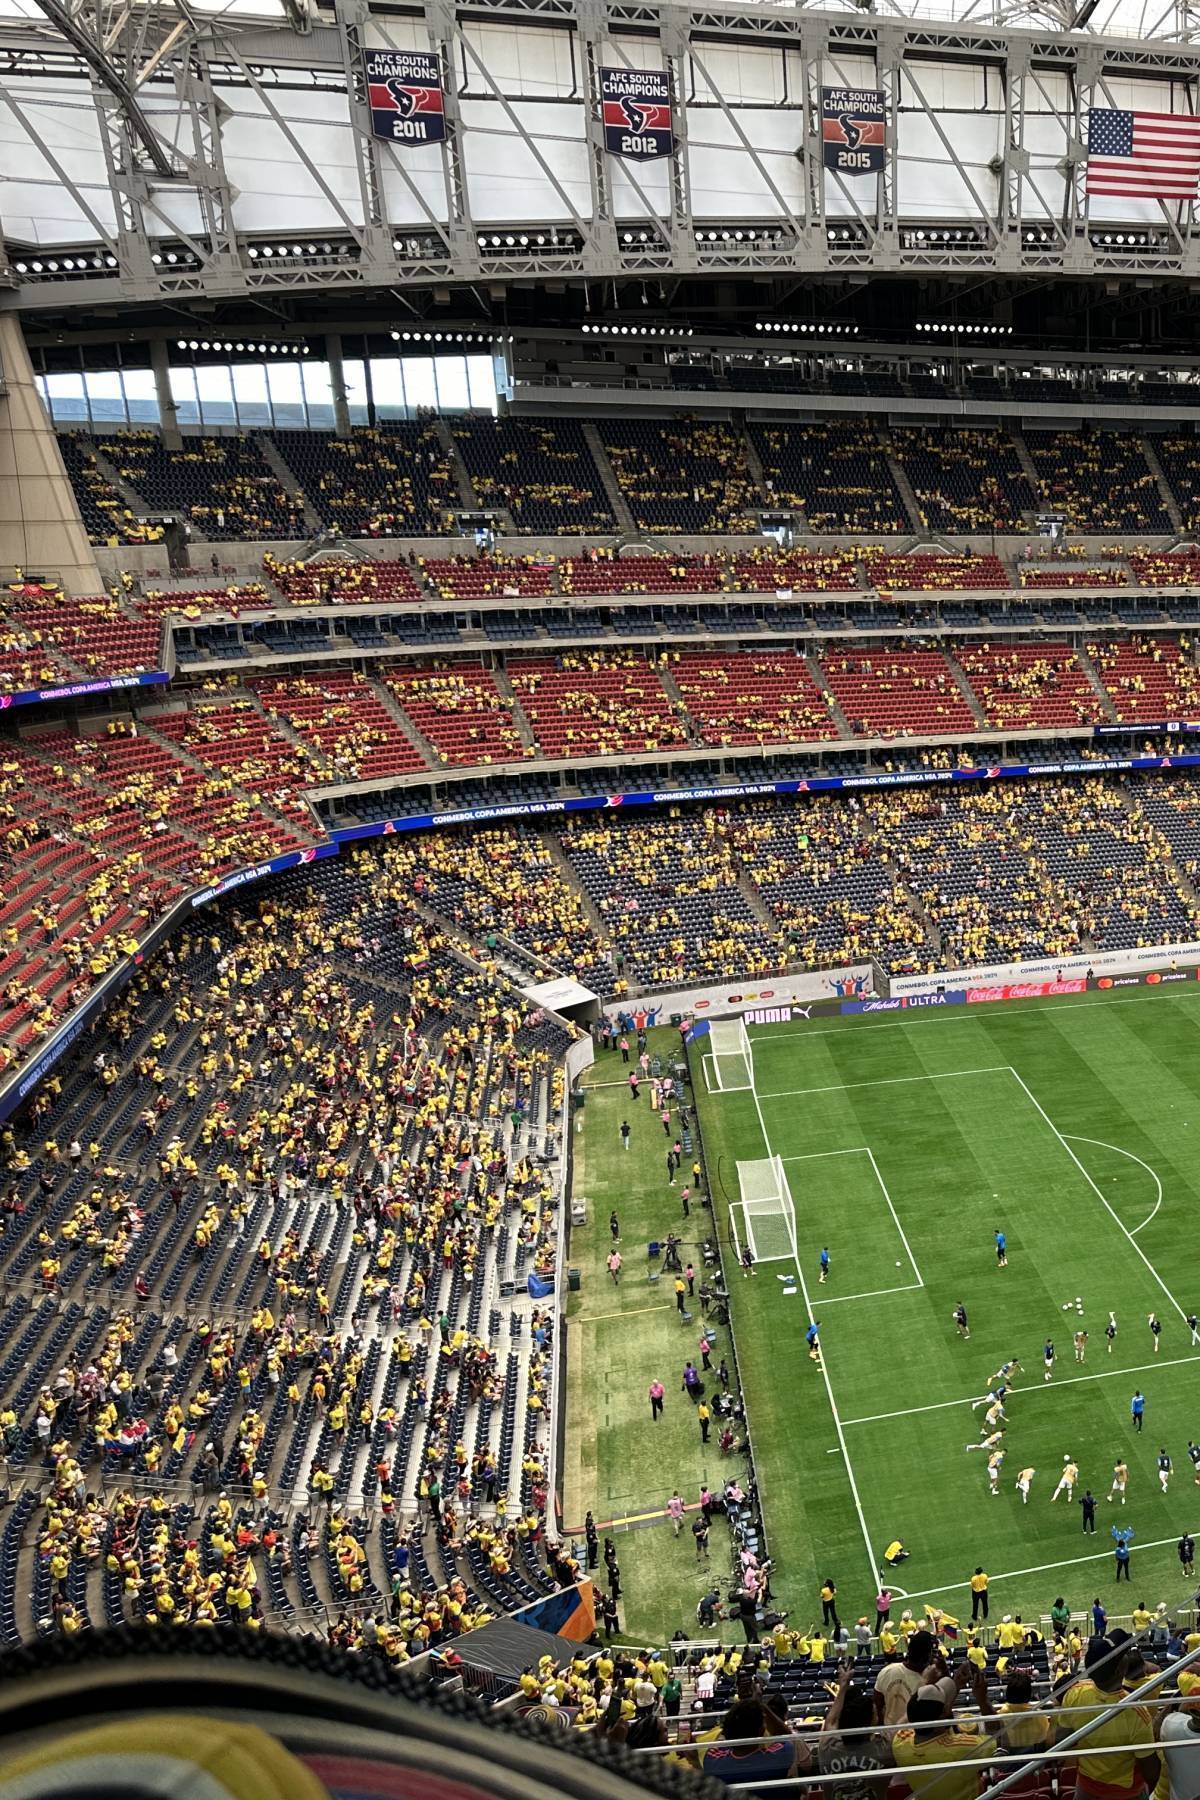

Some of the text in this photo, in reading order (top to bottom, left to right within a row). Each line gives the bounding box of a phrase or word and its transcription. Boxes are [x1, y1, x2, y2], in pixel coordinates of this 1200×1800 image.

[374, 54, 430, 67] AFC SOUTH
[367, 62, 438, 80] CHAMPIONS
[610, 73, 660, 85] AFC SOUTH
[602, 81, 668, 97] CHAMPIONS
[830, 91, 877, 102] AFC SOUTH
[824, 100, 884, 113] CHAMPIONS
[393, 120, 427, 139] 2011
[621, 136, 658, 154] 2012
[838, 152, 871, 168] 2015
[894, 774, 923, 783] AMERICA
[653, 792, 694, 801] CONMEBOL
[713, 788, 744, 796] AMERICA
[432, 802, 565, 824] CONMEBOL COPA AMERICA USA 2024
[1114, 973, 1187, 986] priceless priceless
[909, 995, 946, 1006] ULTRA
[744, 1007, 791, 1025] PUMA
